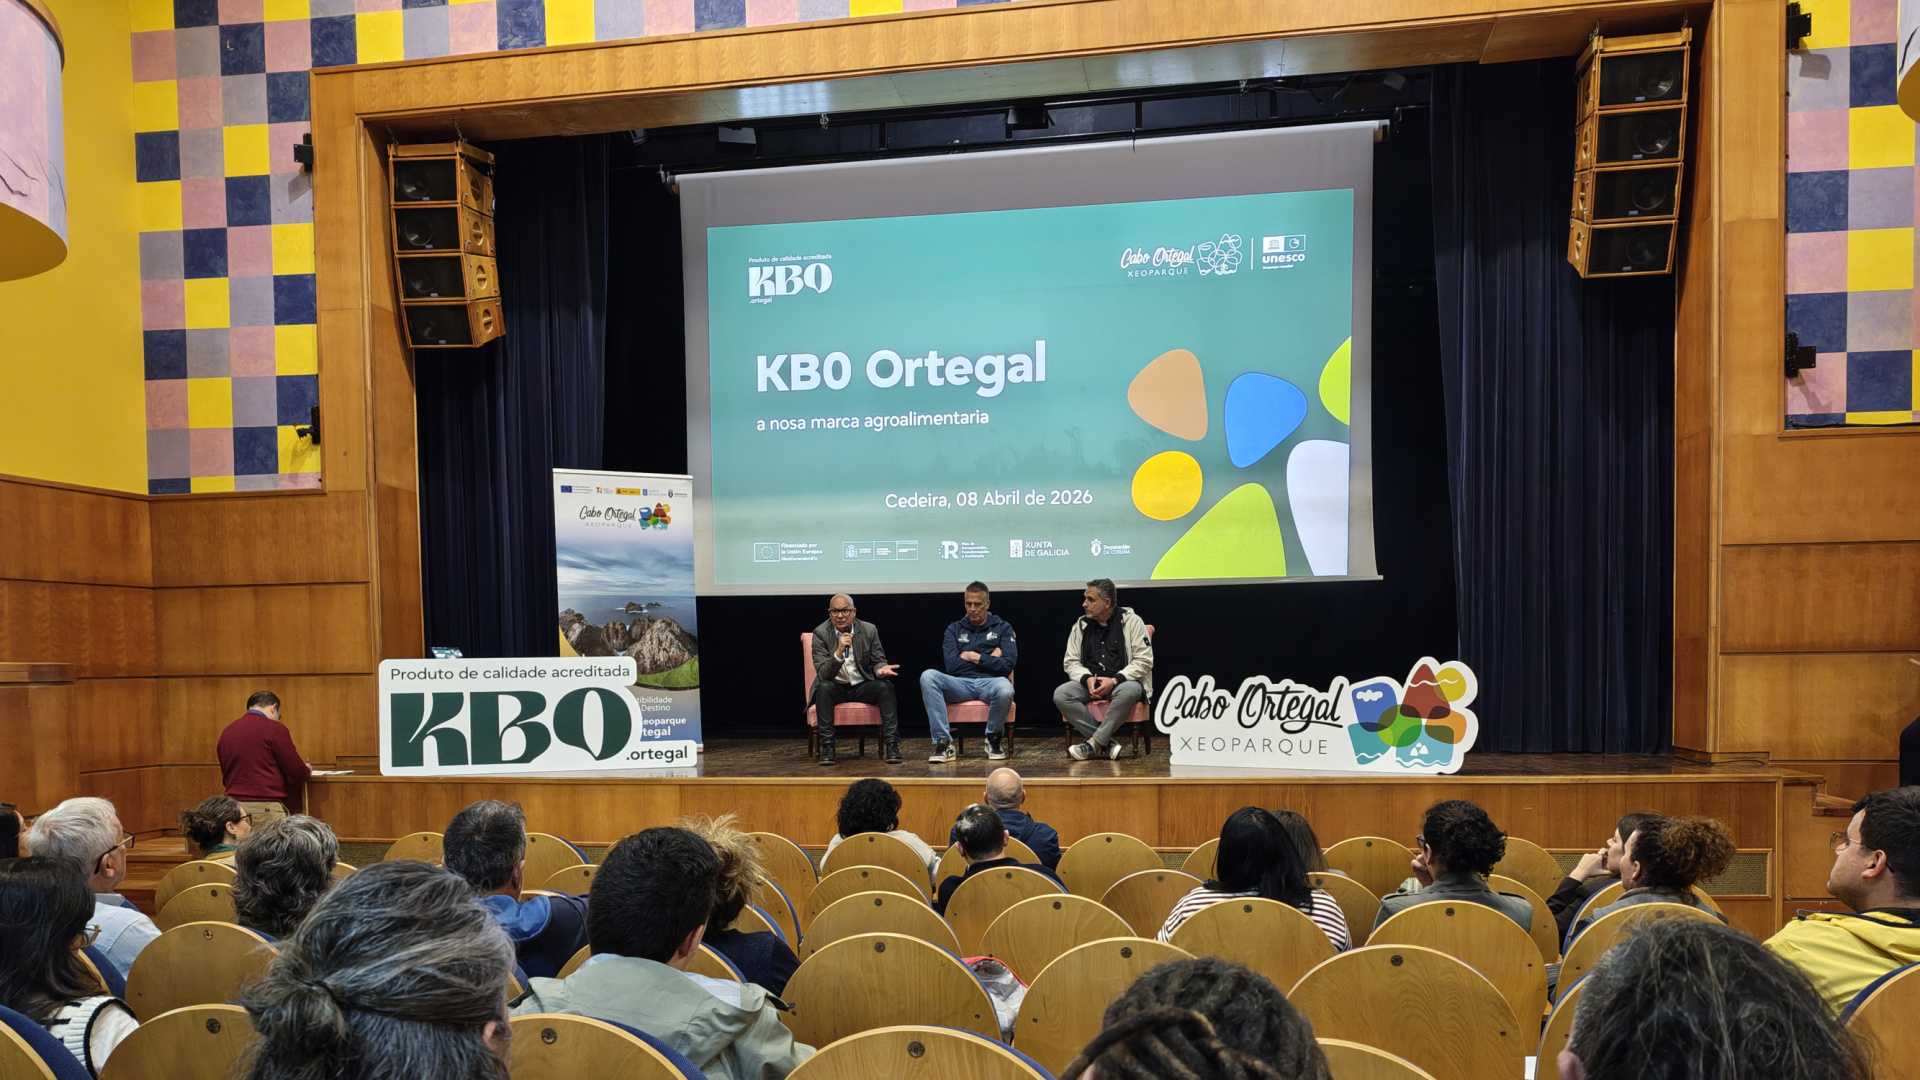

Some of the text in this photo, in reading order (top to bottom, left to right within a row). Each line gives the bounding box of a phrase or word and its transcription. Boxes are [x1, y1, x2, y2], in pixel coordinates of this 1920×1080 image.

[803, 253, 832, 261] acreditada
[1120, 245, 1195, 269] Cabo Ortegal
[1262, 253, 1306, 264] unesco
[1127, 268, 1188, 278] XEOPARQUE
[866, 339, 1046, 398] Ortegal
[756, 410, 990, 432] a nosa marca agroalimentaria
[885, 489, 1093, 509] Cedeira, 08 Abril de 2026
[579, 506, 637, 522] Cabo Ortegal
[1025, 540, 1053, 549] XUNTA
[1025, 548, 1070, 557] DE GALICIA
[390, 664, 630, 681] Produto de calidade acreditada
[636, 696, 673, 704] tibilidade
[1160, 681, 1344, 734] Cabo Ortegal
[390, 687, 632, 767] KBO
[641, 718, 687, 727] eoparque
[642, 726, 671, 738] tegal
[1180, 736, 1328, 756] XEOPARQUE
[626, 746, 688, 763] .ortegal
